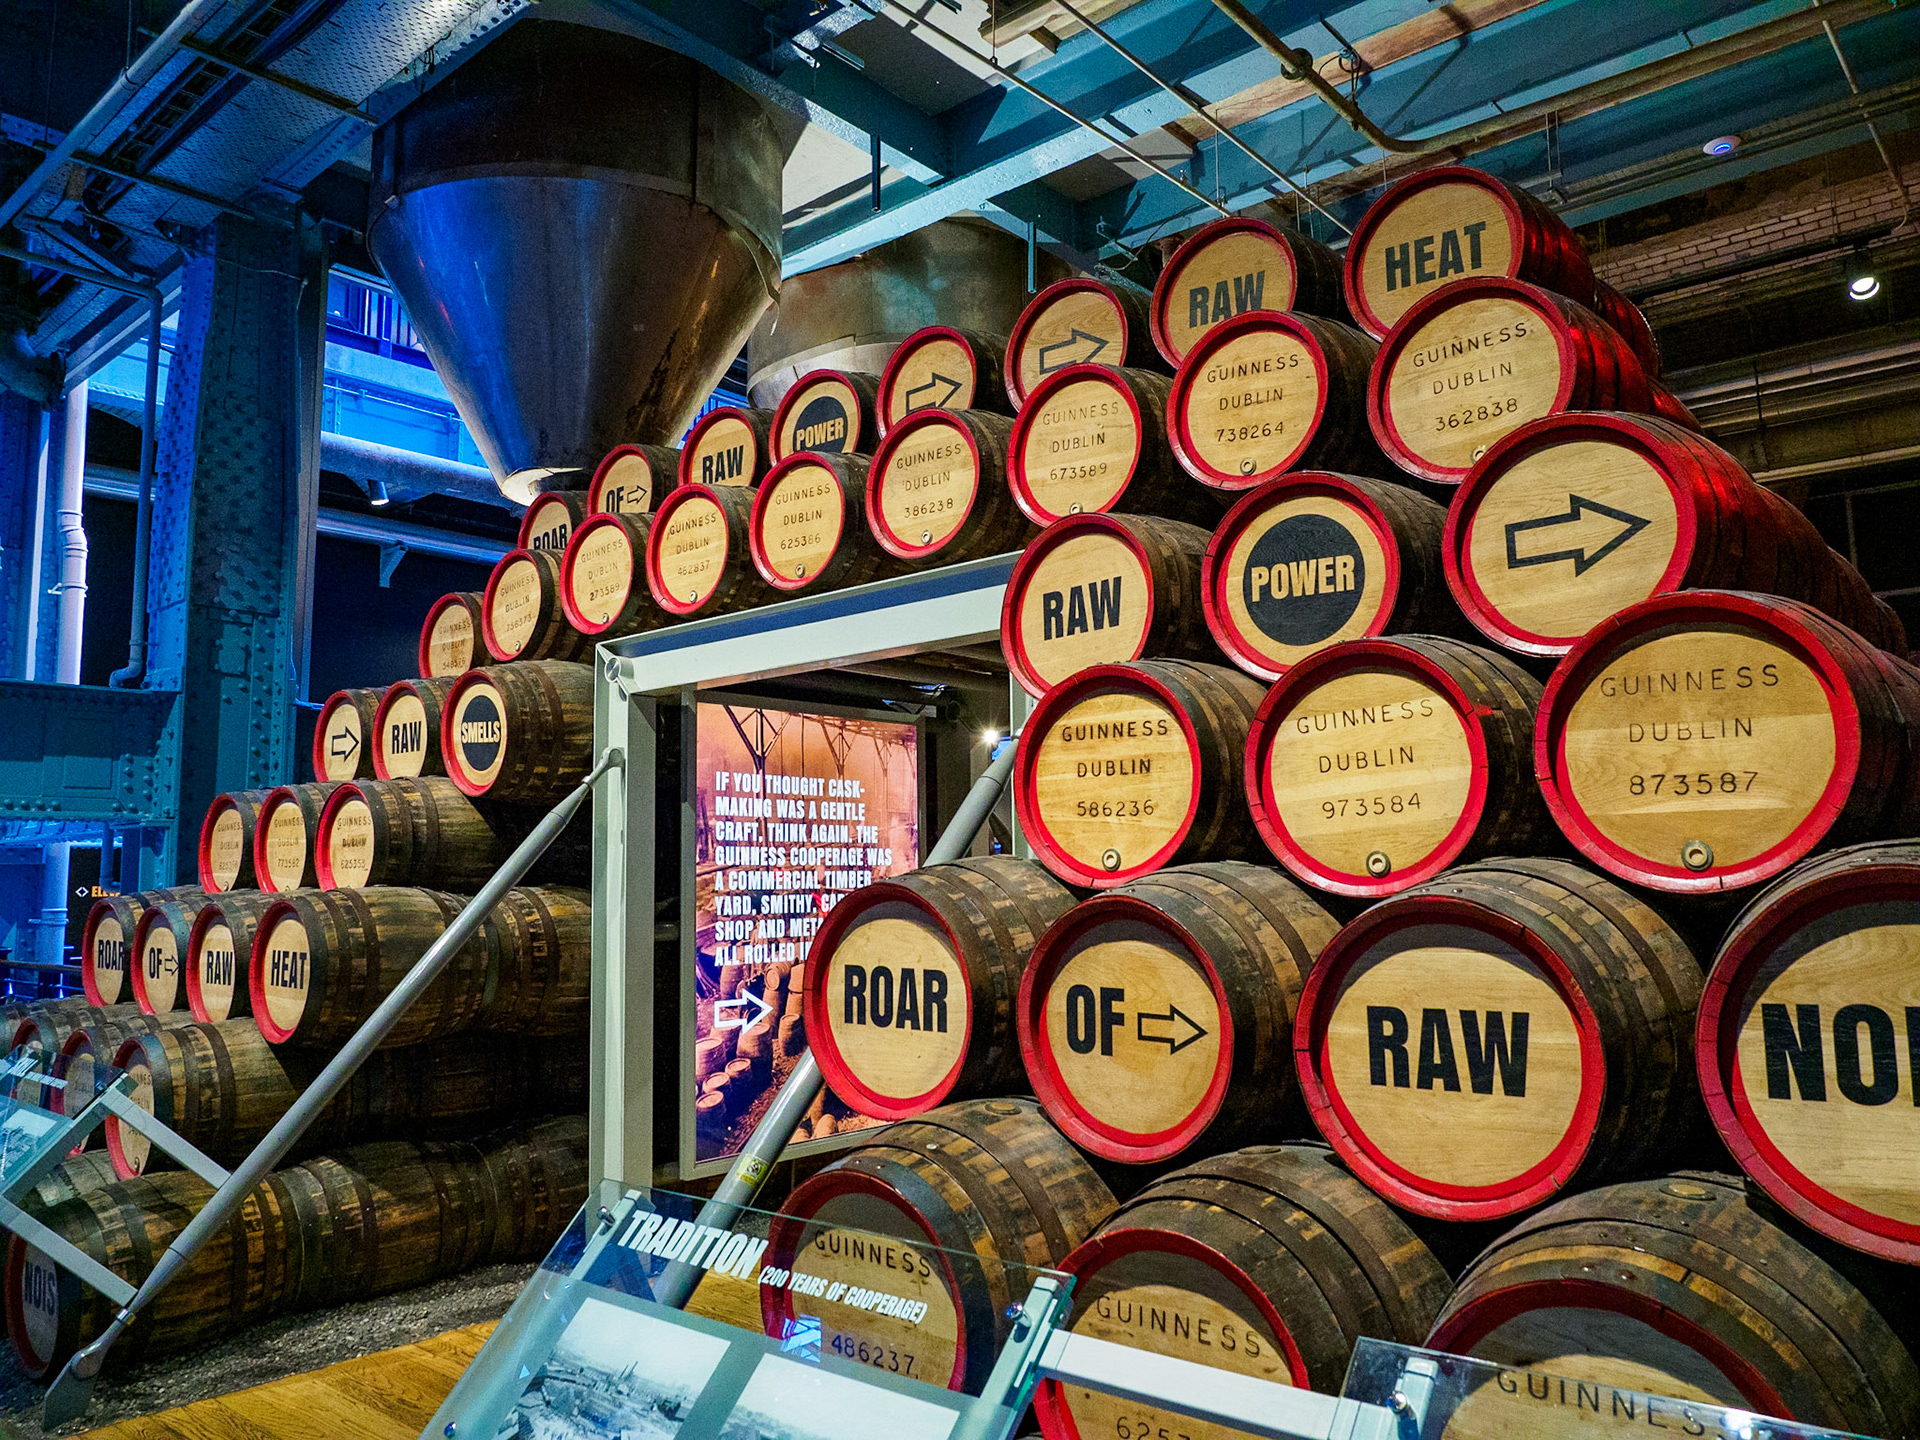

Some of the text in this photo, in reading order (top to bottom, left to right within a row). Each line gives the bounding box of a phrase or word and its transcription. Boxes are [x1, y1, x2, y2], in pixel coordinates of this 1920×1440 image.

[1384, 221, 1487, 293] HEAT
[1188, 270, 1266, 329] RAW
[1412, 322, 1528, 368] GUINNESS
[1206, 354, 1300, 384] GUINNESS
[1432, 361, 1513, 395] DUBLIN
[1219, 387, 1284, 412] DUBLIN
[1042, 402, 1120, 427] GUINNESS
[1435, 398, 1519, 432] 362838
[796, 416, 845, 450] POWER
[1051, 432, 1106, 454] DUBLIN
[1215, 421, 1285, 444] 738264
[702, 445, 744, 483] RAW
[896, 443, 963, 470] GUINNESS
[904, 470, 951, 492] DUBLIN
[1049, 462, 1108, 482] 673589
[605, 486, 625, 513] OF
[775, 483, 832, 506] GUINNESS
[782, 509, 823, 526] DUBLIN
[903, 498, 955, 519] 386238
[669, 512, 718, 536] GUINNESS
[580, 538, 624, 564] GUINNESS
[676, 537, 709, 555] DUBLIN
[780, 532, 822, 550] 625386
[588, 562, 618, 580] DUBLIN
[677, 560, 711, 576] 462837
[1251, 554, 1356, 603] POWER
[500, 573, 535, 597] GUINNESS
[589, 583, 621, 602] 273589
[505, 594, 530, 613] DUBLIN
[1042, 575, 1123, 641] RAW
[441, 639, 465, 652] DUBLIN
[1599, 663, 1781, 699] GUINNESS
[1296, 698, 1435, 735] GUINNESS
[391, 720, 422, 754] RAW
[460, 720, 502, 745] SMELLS
[1061, 719, 1170, 743] GUINNESS
[1628, 716, 1753, 744] DUBLIN
[1076, 758, 1152, 778] DUBLIN
[1318, 745, 1415, 774] DUBLIN
[715, 770, 866, 799] IF YOU THOUGHT CASK-
[1629, 770, 1760, 797] 873587
[715, 795, 866, 821] MAKING WAS A GENTLE
[1076, 799, 1155, 818] 586236
[1321, 792, 1422, 820] 973584
[274, 817, 304, 828] GUINNESS
[337, 815, 372, 827] GUINNESS
[715, 820, 879, 844] CRAFT, THINK AGAIN. THE
[277, 838, 299, 848] DUBLIN
[342, 837, 367, 847] DUBLIN
[714, 845, 893, 867] GUINNESS COOPERAGE WAS
[714, 870, 873, 891] A COMMERCIAL TIMBER
[714, 894, 757, 917] YARD,
[714, 920, 754, 941] SHOP
[757, 918, 786, 939] AND
[98, 939, 125, 972] ROAR
[149, 947, 163, 980] OF
[714, 945, 740, 967] ALL
[744, 942, 796, 965] ROLLED
[206, 950, 233, 986] RAW
[270, 949, 308, 990] HEAT
[843, 964, 948, 1033] ROAR
[1066, 984, 1125, 1057] OF
[1366, 1005, 1530, 1098] RAW
[617, 1209, 769, 1281] TRADITION
[813, 1230, 931, 1279] GUINNESS
[757, 1264, 929, 1326] (200 YEARS OF COOPERAGE)
[1096, 1295, 1262, 1358] GUINNESS
